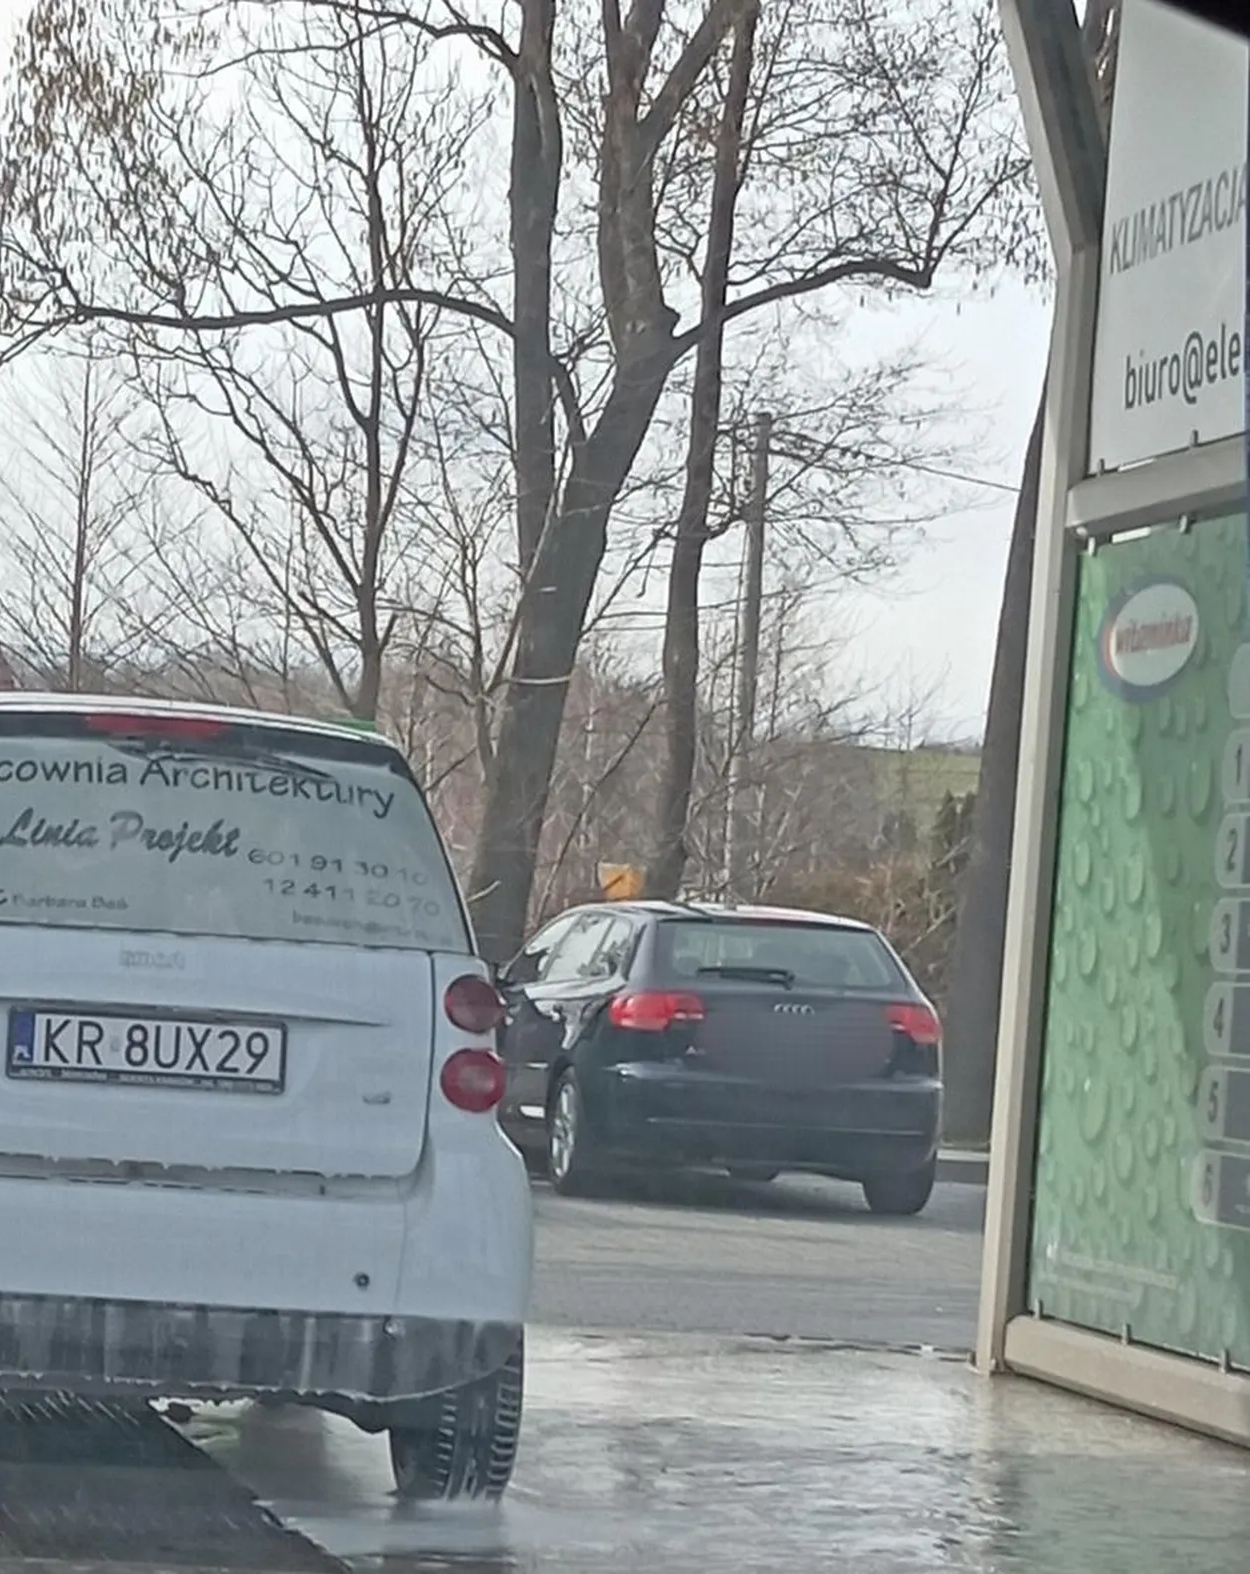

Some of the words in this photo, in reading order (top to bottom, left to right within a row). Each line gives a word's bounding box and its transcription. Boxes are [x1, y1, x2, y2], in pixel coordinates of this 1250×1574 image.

[139, 756, 395, 820] Architektury
[109, 809, 241, 864] Projekt
[1224, 827, 1238, 873] 2
[247, 848, 300, 867] 601
[310, 854, 343, 873] 91
[263, 877, 296, 896] 12
[1219, 912, 1232, 955] 3
[43, 1017, 105, 1066] KR
[124, 1023, 270, 1076] 8UX29
[1206, 1080, 1219, 1125] 5
